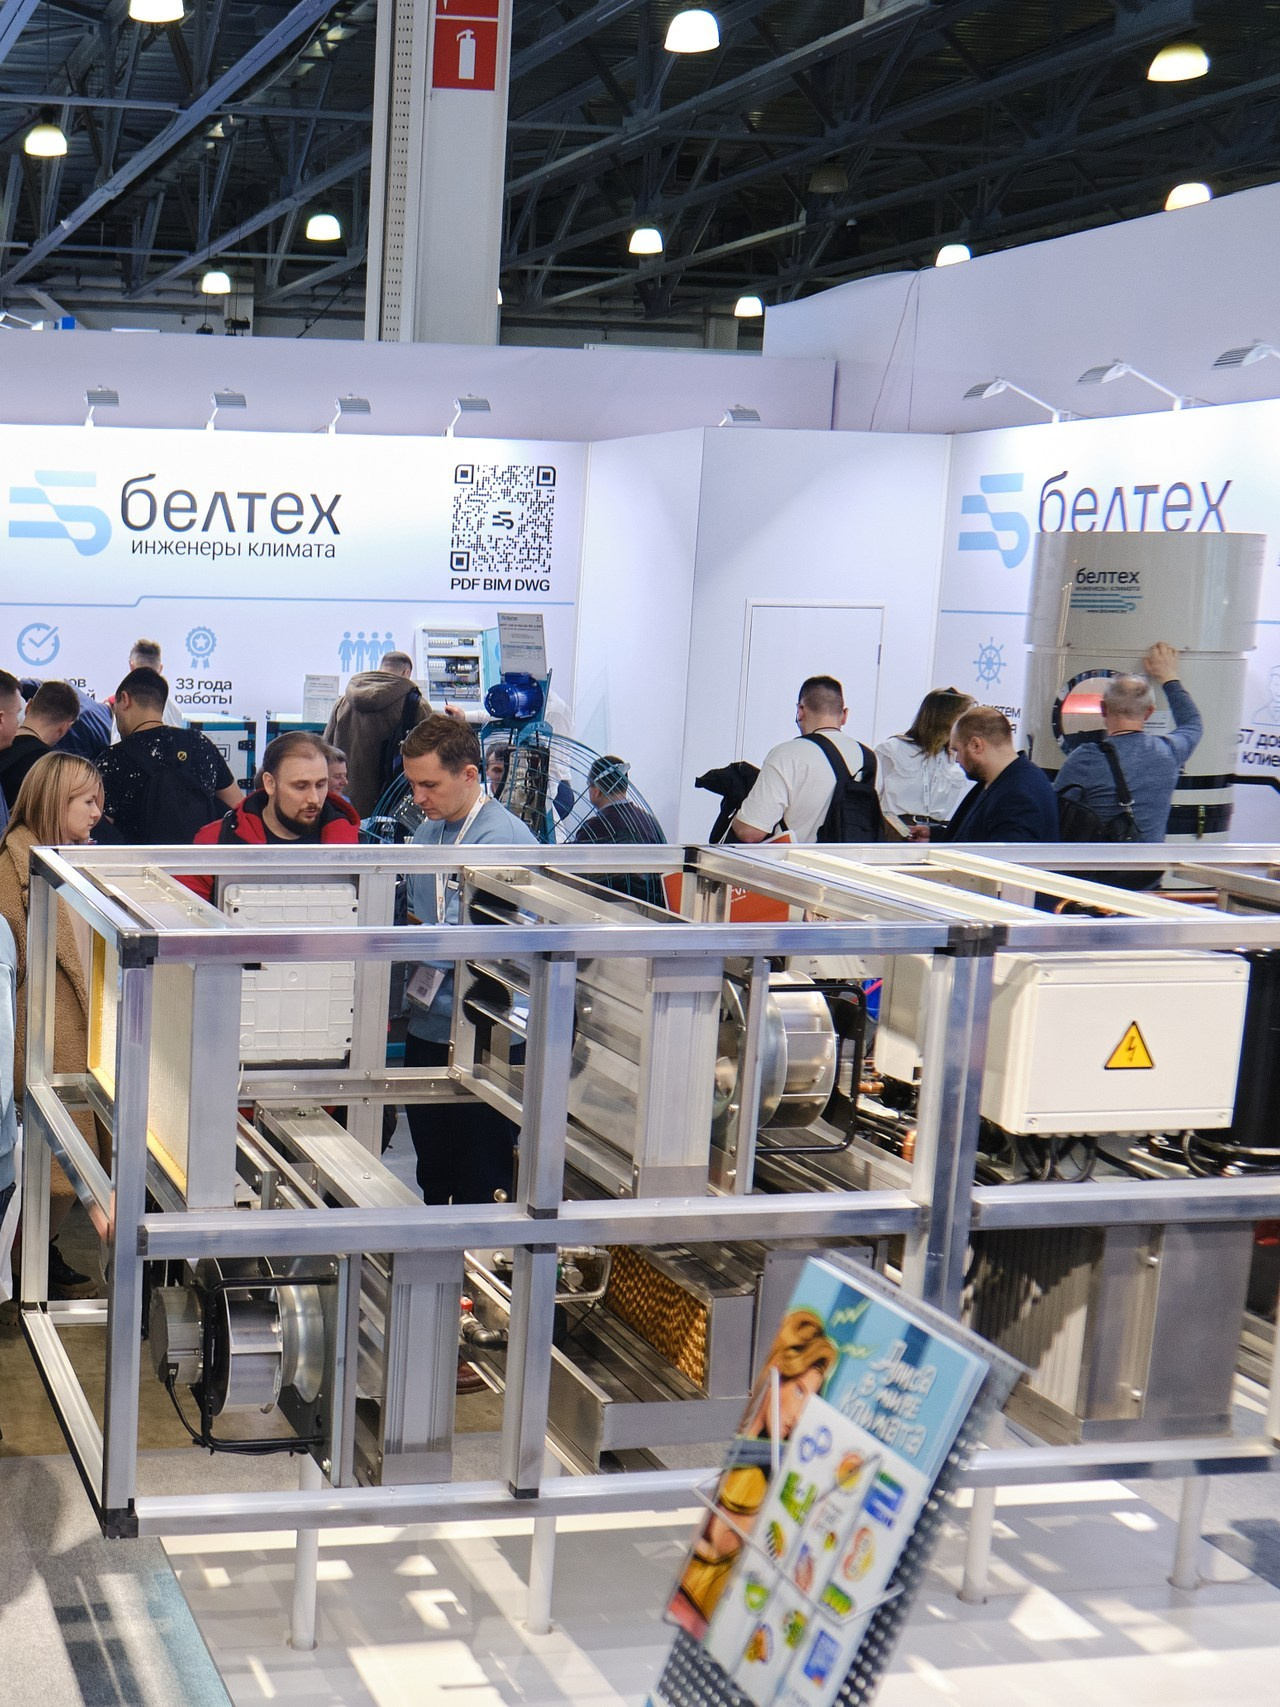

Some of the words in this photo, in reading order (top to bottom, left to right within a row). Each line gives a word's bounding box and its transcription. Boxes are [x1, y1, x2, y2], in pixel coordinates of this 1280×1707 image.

[120, 473, 342, 536] белтех
[1038, 470, 1233, 533] белтех
[131, 540, 241, 561] инженеры
[248, 542, 336, 559] климата
[1076, 567, 1140, 584] белтех
[450, 577, 480, 590] PDF
[483, 578, 511, 591] BIM
[514, 579, 550, 592] DWG
[175, 678, 194, 689] 33
[198, 679, 233, 692] года
[175, 691, 233, 704] работы
